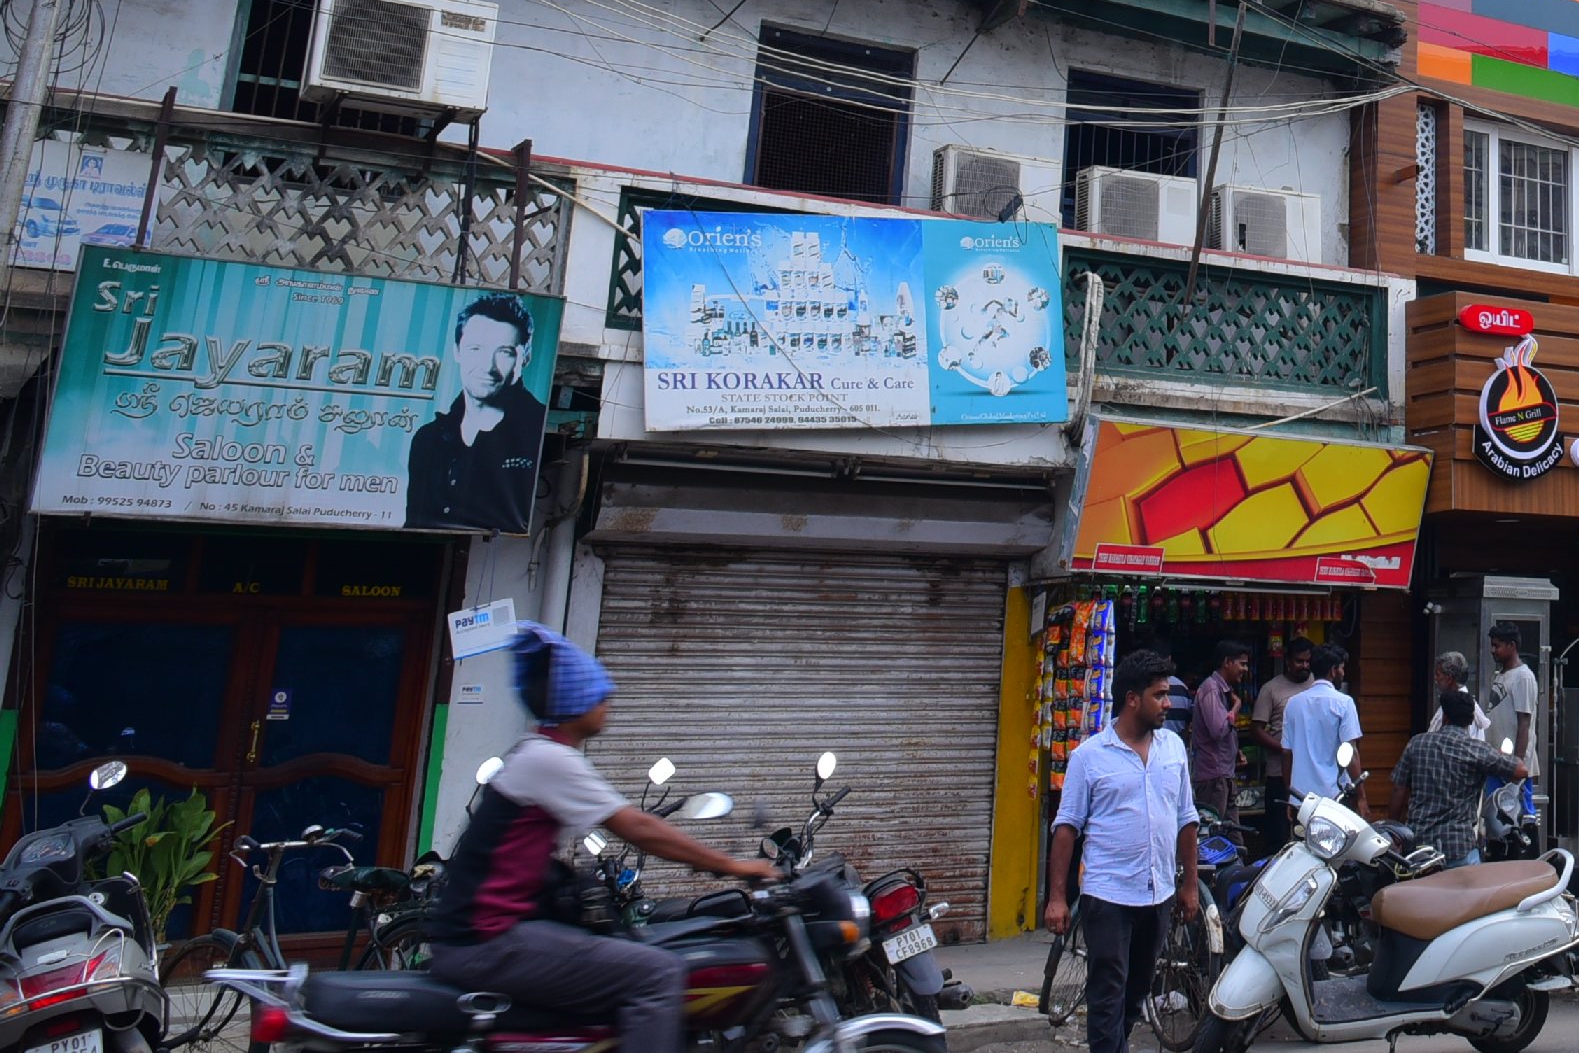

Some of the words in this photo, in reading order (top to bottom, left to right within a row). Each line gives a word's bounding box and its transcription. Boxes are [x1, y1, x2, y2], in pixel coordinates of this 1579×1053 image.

[93, 280, 161, 316] Sri
[1478, 309, 1521, 330] ஒயிட்
[103, 317, 441, 392] Jayaram
[657, 372, 697, 390] SRI
[705, 372, 825, 390] KORAKAR
[830, 377, 863, 390] Cure
[867, 378, 879, 389] &
[883, 376, 914, 390] Care
[721, 393, 763, 403] STATE
[764, 393, 805, 403] STOCK
[808, 393, 848, 402] POINT
[730, 404, 767, 416] Kamaraj
[793, 404, 842, 416] Puducherry
[1494, 414, 1517, 427] Flame
[1517, 410, 1525, 421] N
[1525, 408, 1542, 421] Grill
[172, 432, 286, 464] Saloon
[293, 444, 316, 466] &
[1481, 440, 1521, 479] Arabian
[1522, 441, 1564, 480] Delicacy
[76, 453, 182, 489] Beauty
[184, 462, 291, 490] parlour
[294, 467, 335, 492] for
[338, 473, 399, 495] men
[61, 494, 89, 505] Mob
[240, 503, 286, 516] Kamaraj
[286, 505, 311, 516] Salai
[312, 507, 373, 520] Puducherry
[67, 575, 96, 589] SRI
[97, 577, 169, 591] JAYARAM
[341, 584, 402, 597] SALOON
